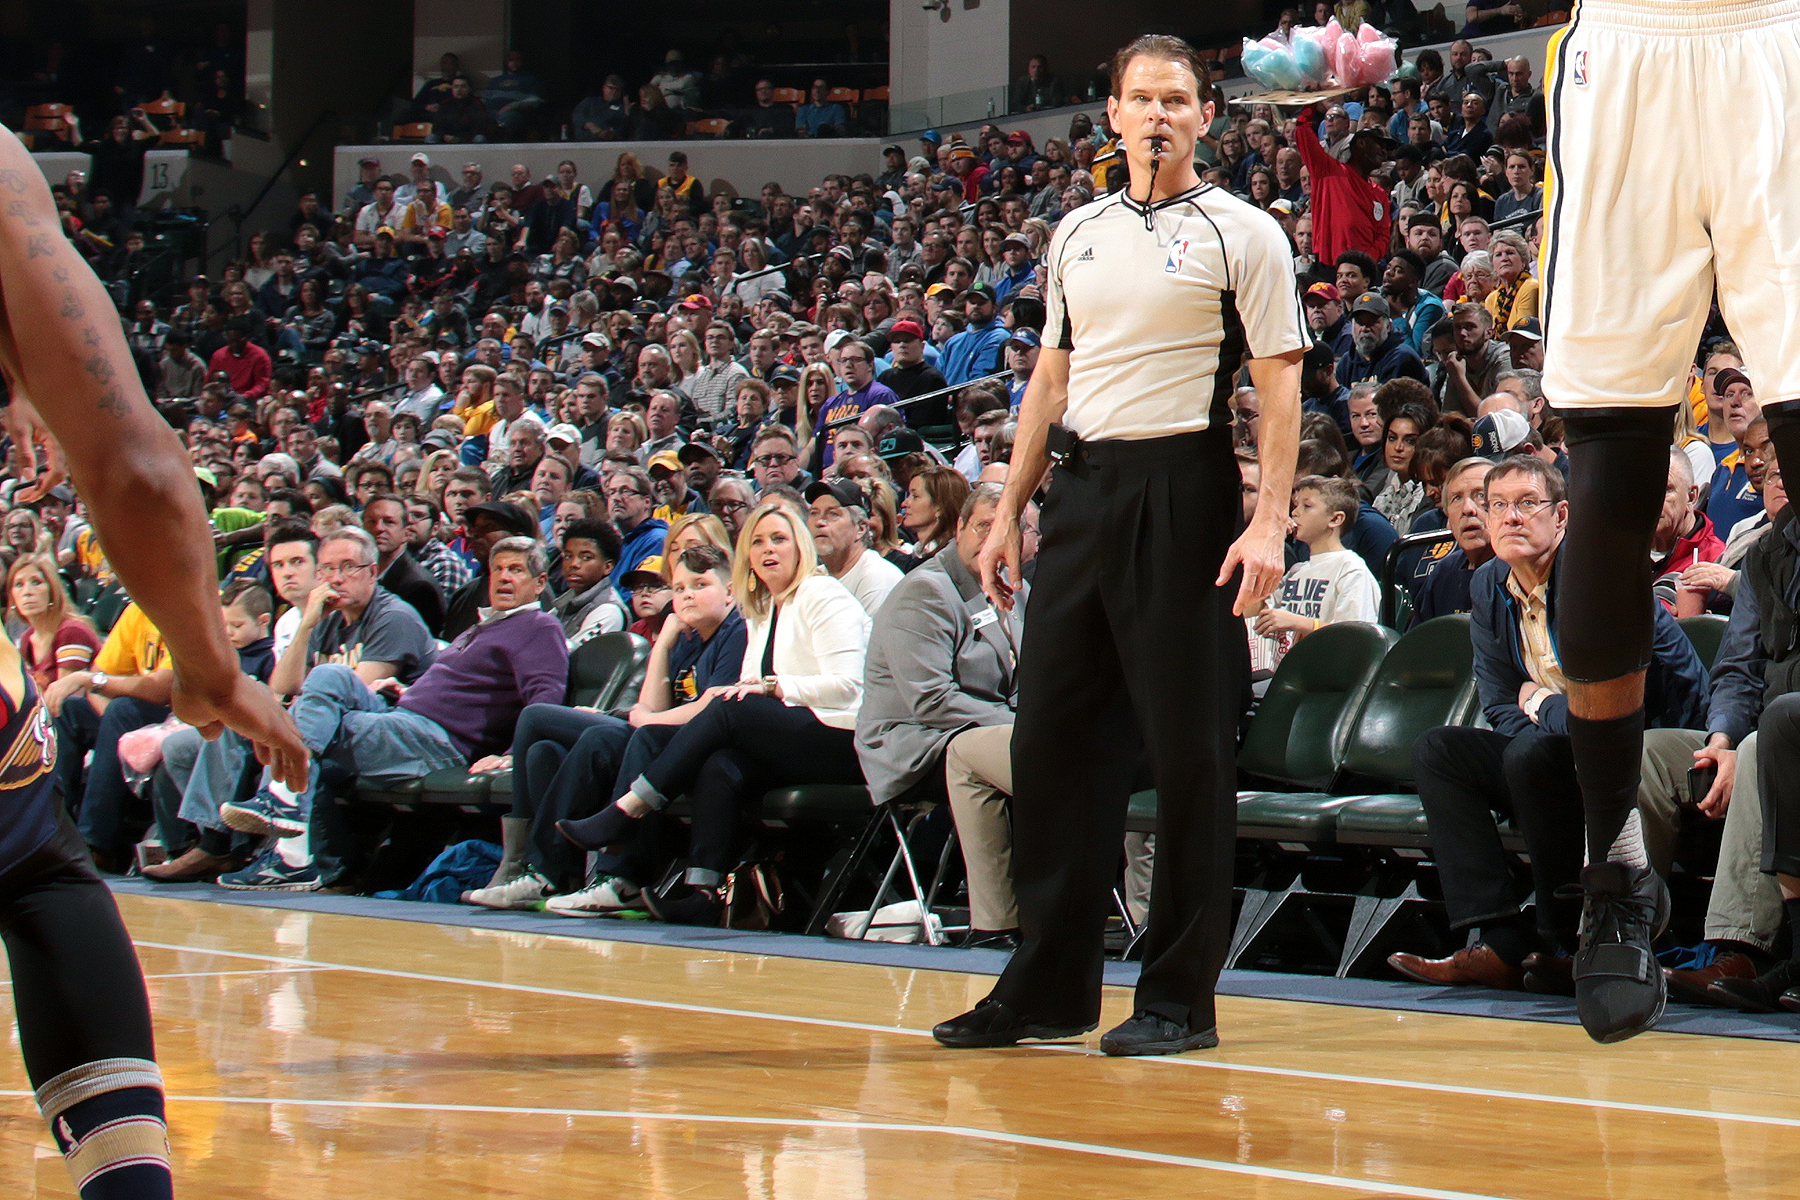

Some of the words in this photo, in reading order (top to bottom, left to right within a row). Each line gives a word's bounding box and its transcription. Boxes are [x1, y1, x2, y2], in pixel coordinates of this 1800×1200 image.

[152, 163, 168, 190] 13
[1282, 578, 1330, 601] BLUE
[1281, 602, 1322, 619] OLLAR
